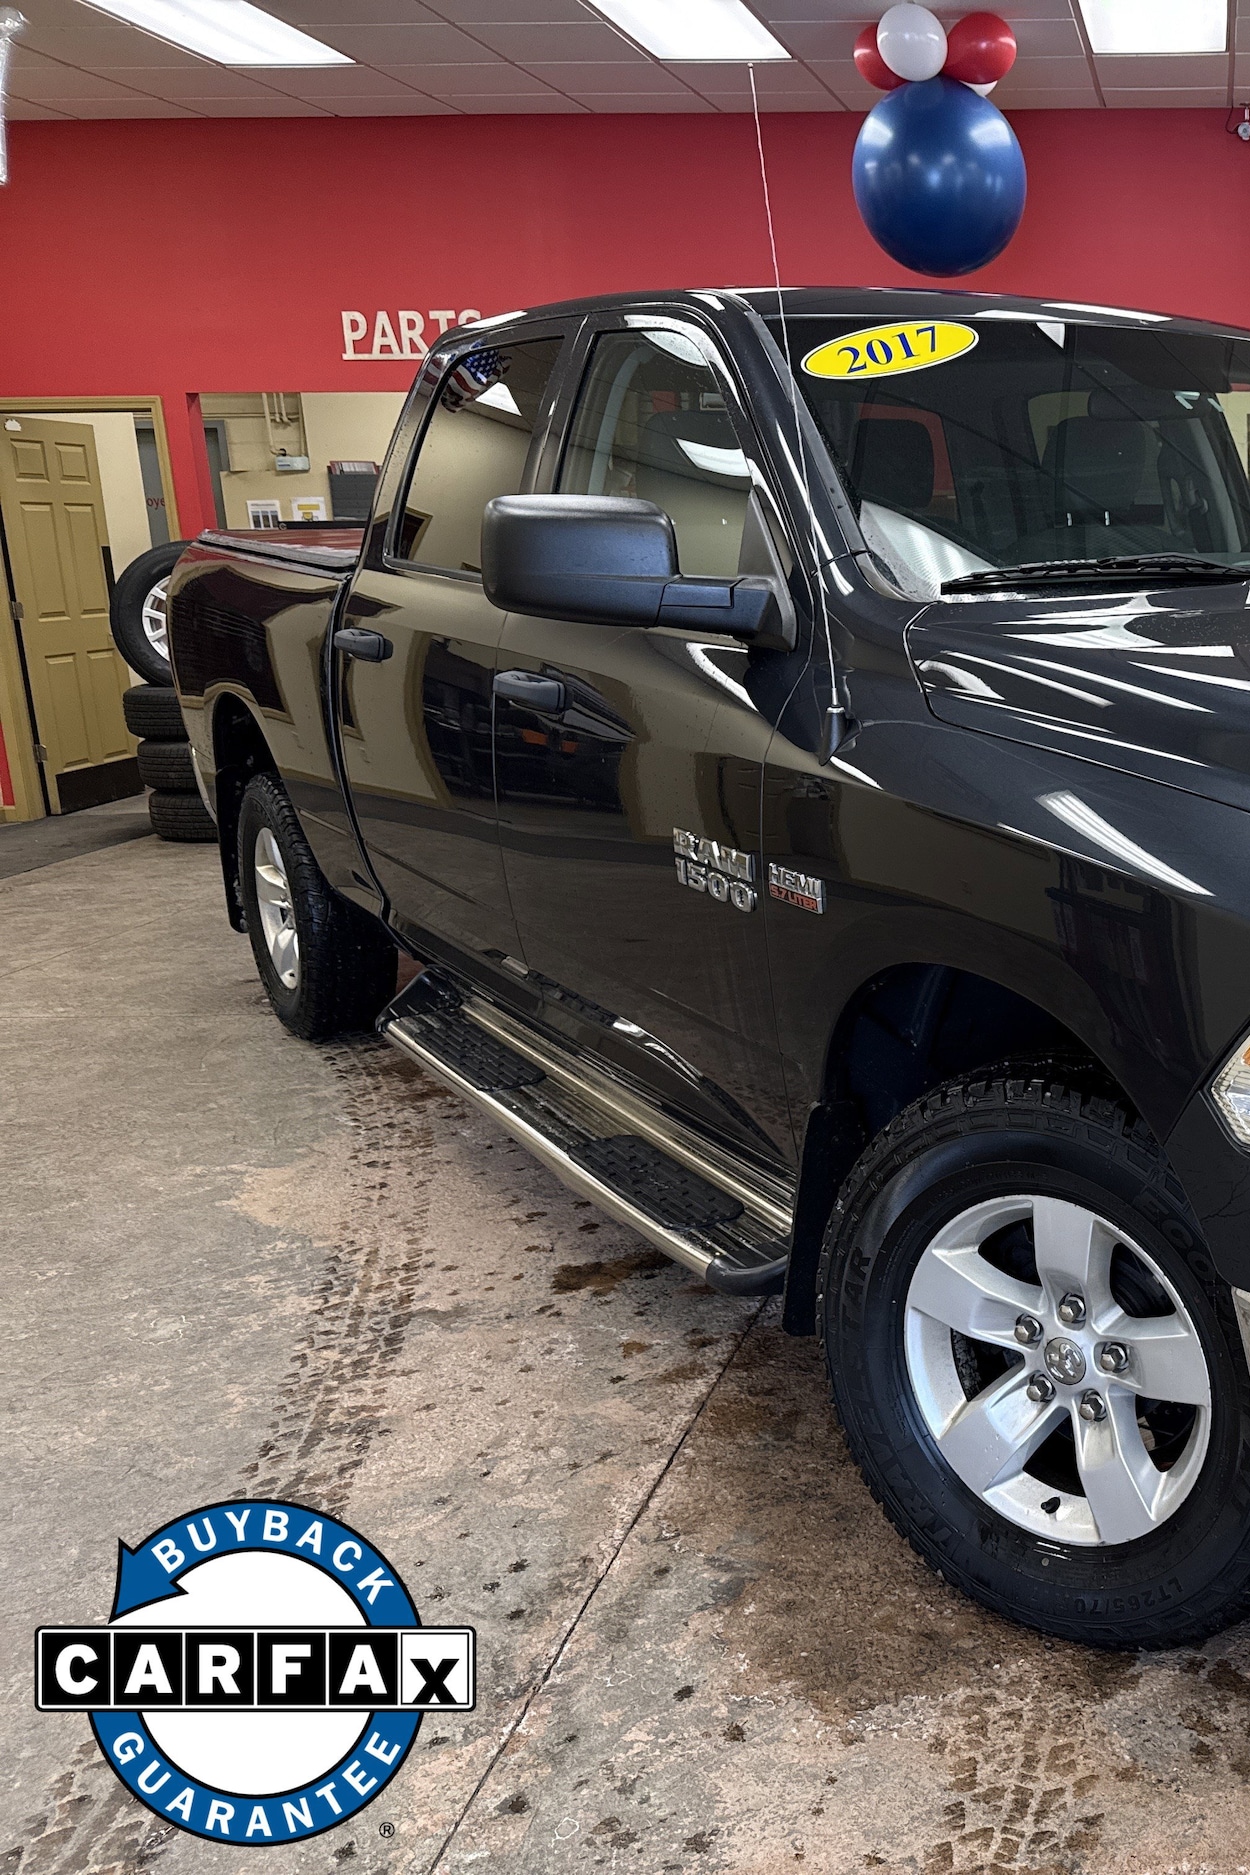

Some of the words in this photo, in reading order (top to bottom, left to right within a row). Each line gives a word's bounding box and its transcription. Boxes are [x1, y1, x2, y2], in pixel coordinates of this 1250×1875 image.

[837, 325, 936, 374] 2017
[672, 827, 755, 882] RAM
[768, 862, 826, 897] HEMI
[675, 857, 758, 913] 1500
[770, 884, 788, 899] 5.7
[788, 892, 818, 911] LITER
[841, 1246, 952, 1545] TRAVELSTAR
